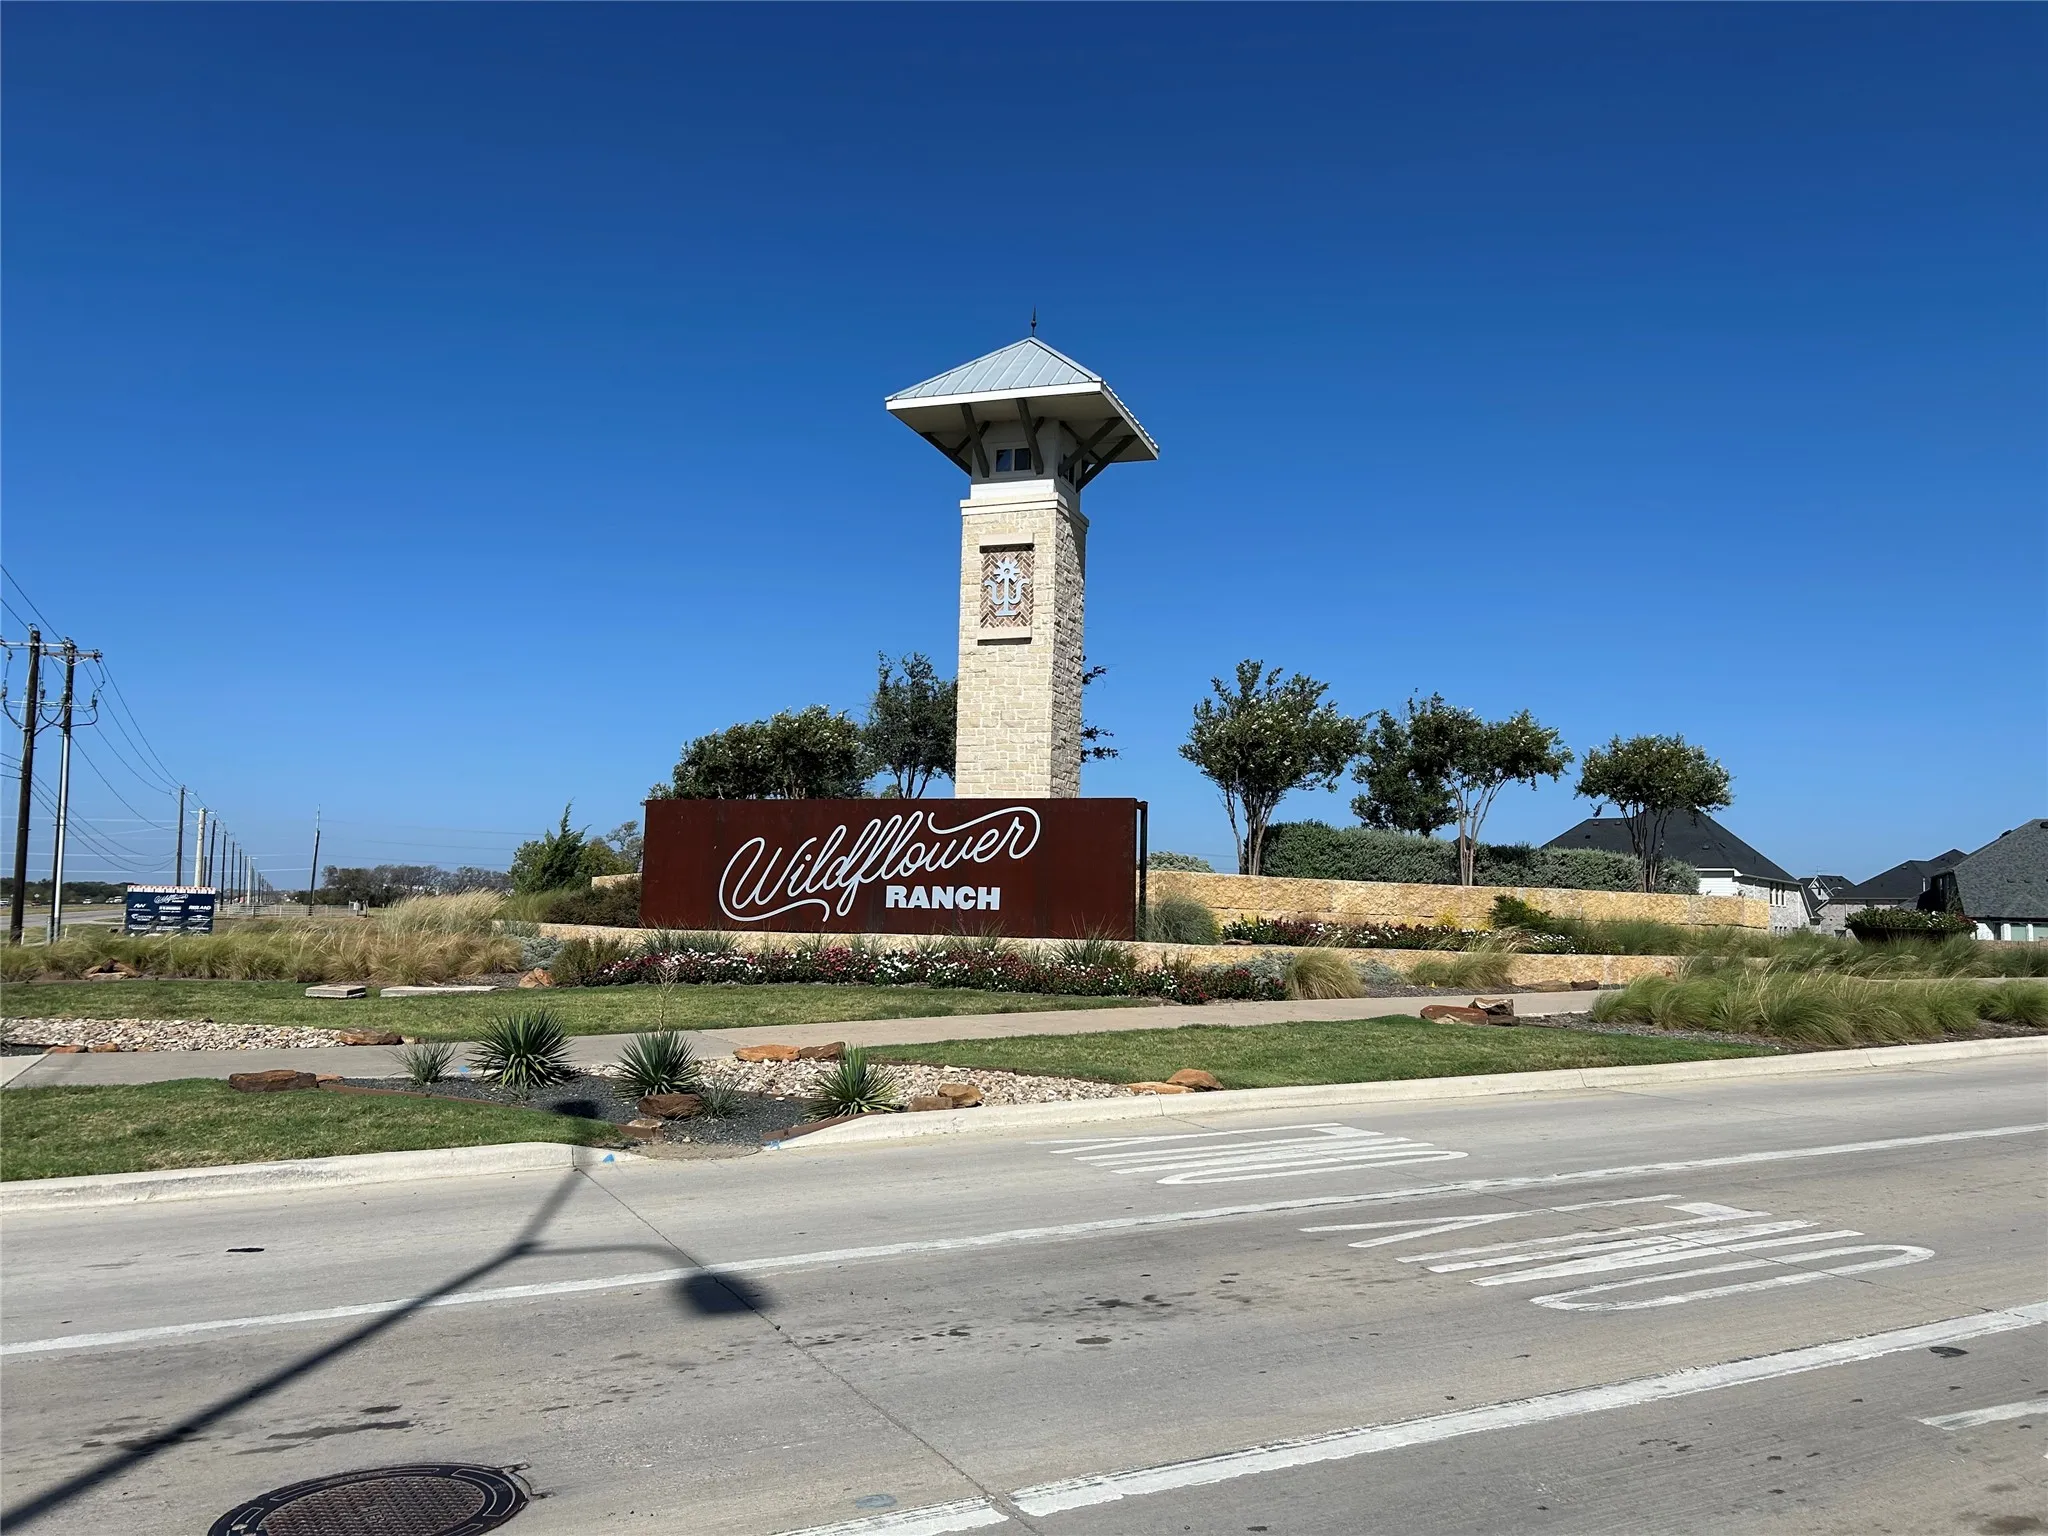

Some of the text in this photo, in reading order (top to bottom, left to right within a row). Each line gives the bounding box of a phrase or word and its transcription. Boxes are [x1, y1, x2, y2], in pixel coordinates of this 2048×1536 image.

[718, 806, 1041, 922] Wildflower
[885, 885, 1001, 911] RANCH
[1026, 1122, 1469, 1185] ONLY
[1299, 1194, 1936, 1312] ONLY
